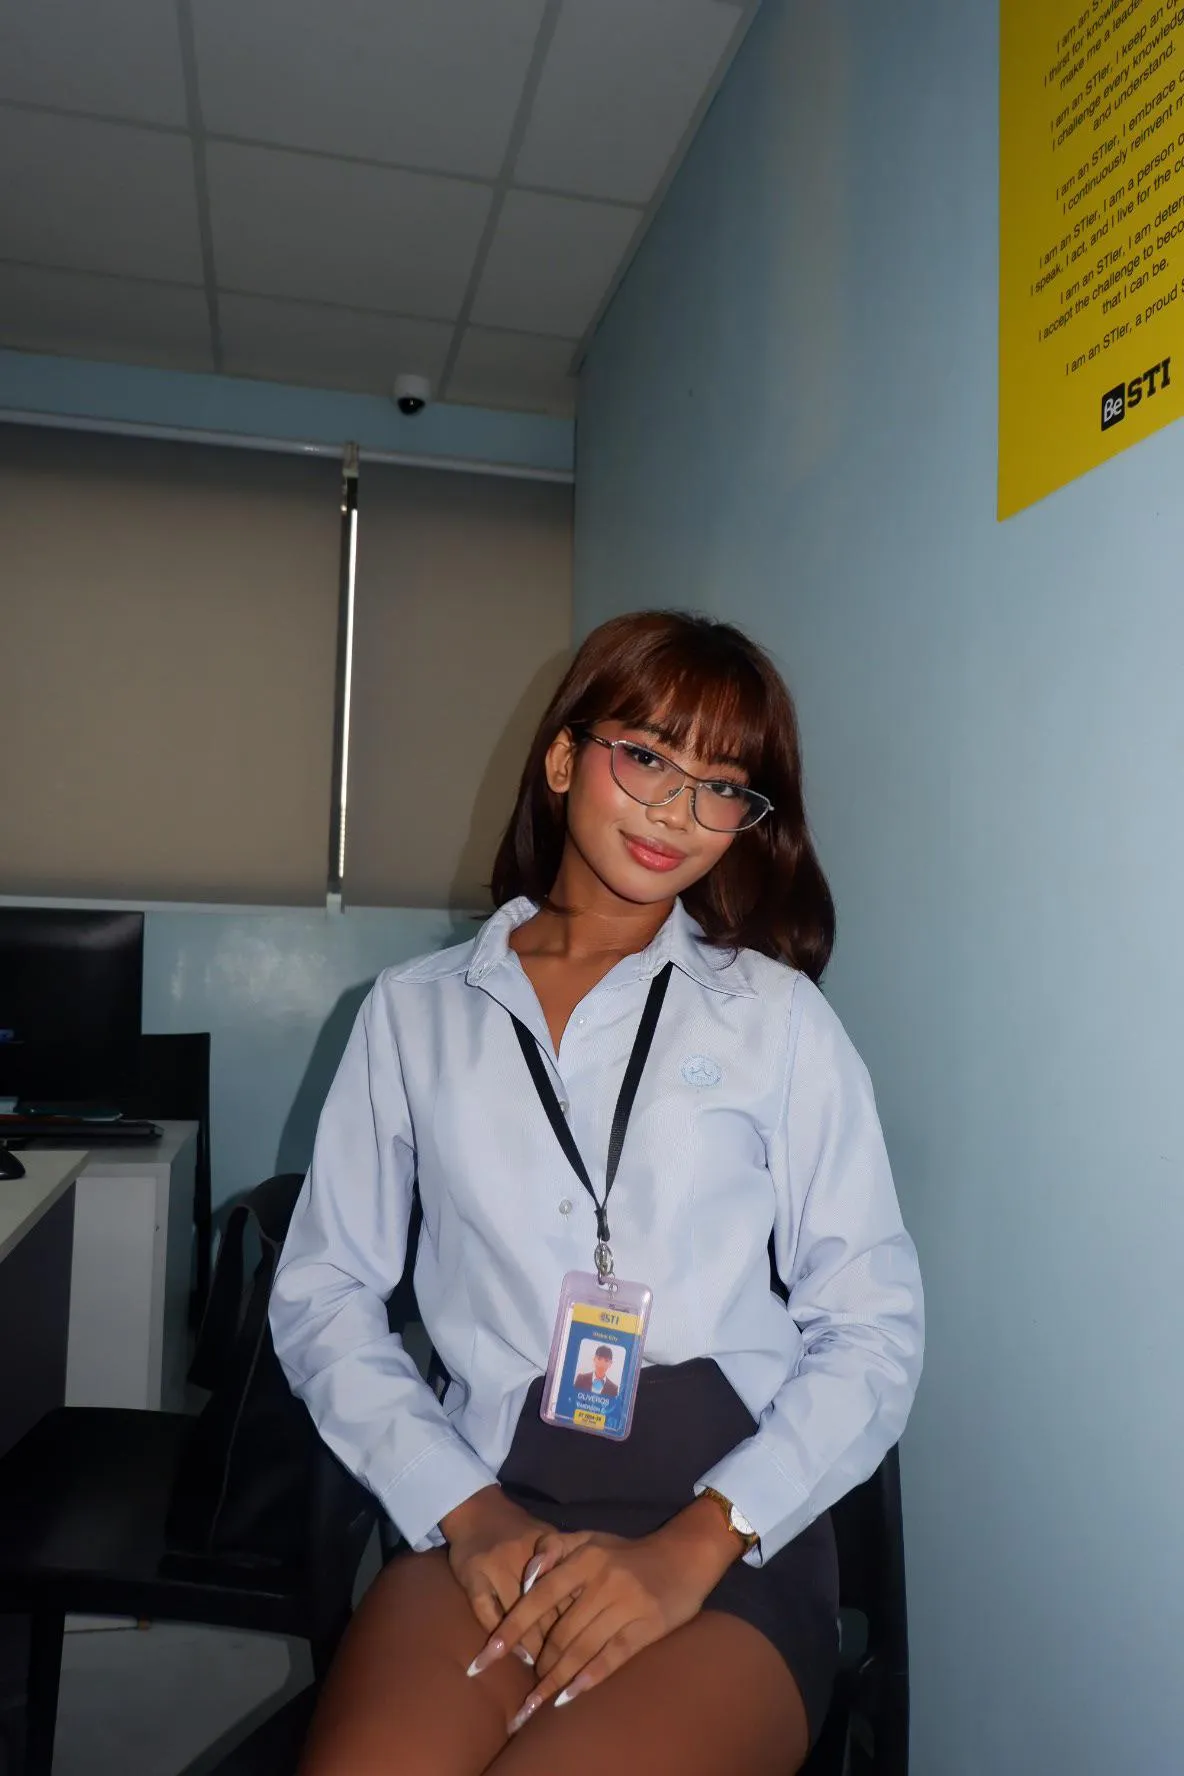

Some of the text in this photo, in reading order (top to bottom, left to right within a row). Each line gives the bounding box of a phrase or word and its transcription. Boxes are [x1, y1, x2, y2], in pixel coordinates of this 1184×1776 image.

[1050, 51, 1069, 81] thirst
[1072, 35, 1084, 55] for
[1086, 0, 1122, 39] knowle
[1055, 106, 1069, 127] am
[1071, 92, 1083, 110] an
[1122, 24, 1146, 56] keep
[1150, 7, 1163, 28] an
[1060, 0, 1143, 89] make me a leade
[1061, 25, 1076, 47] am
[1077, 9, 1089, 29] an
[1057, 96, 1101, 145] challenge
[1103, 65, 1130, 98] every
[1093, 40, 1176, 131] and understand.
[1061, 175, 1076, 197] am
[1077, 162, 1089, 180] an
[1129, 80, 1175, 131] embrace
[1068, 147, 1128, 210] continuously
[1131, 103, 1173, 152] reinvent
[1044, 246, 1058, 264] am
[1060, 234, 1071, 251] an
[1109, 186, 1125, 208] am
[1128, 178, 1134, 191] a
[1137, 142, 1175, 187] person
[1071, 241, 1088, 262] act,
[1090, 218, 1109, 246] and
[1118, 201, 1134, 223] live
[1136, 186, 1151, 206] for
[1153, 169, 1171, 191] the
[1043, 307, 1073, 340] accept
[1074, 295, 1090, 317] the
[1092, 255, 1140, 300] challenge
[1143, 244, 1154, 261] to
[1065, 280, 1080, 300] am
[1081, 269, 1094, 287] an
[1134, 223, 1151, 245] am
[1102, 291, 1121, 315] that
[1130, 271, 1149, 294] can
[1152, 258, 1168, 278] be.
[1071, 353, 1086, 373] am
[1088, 344, 1101, 360] an
[1135, 313, 1142, 327] a
[1145, 283, 1178, 324] proud
[1103, 355, 1171, 423] Be STI
